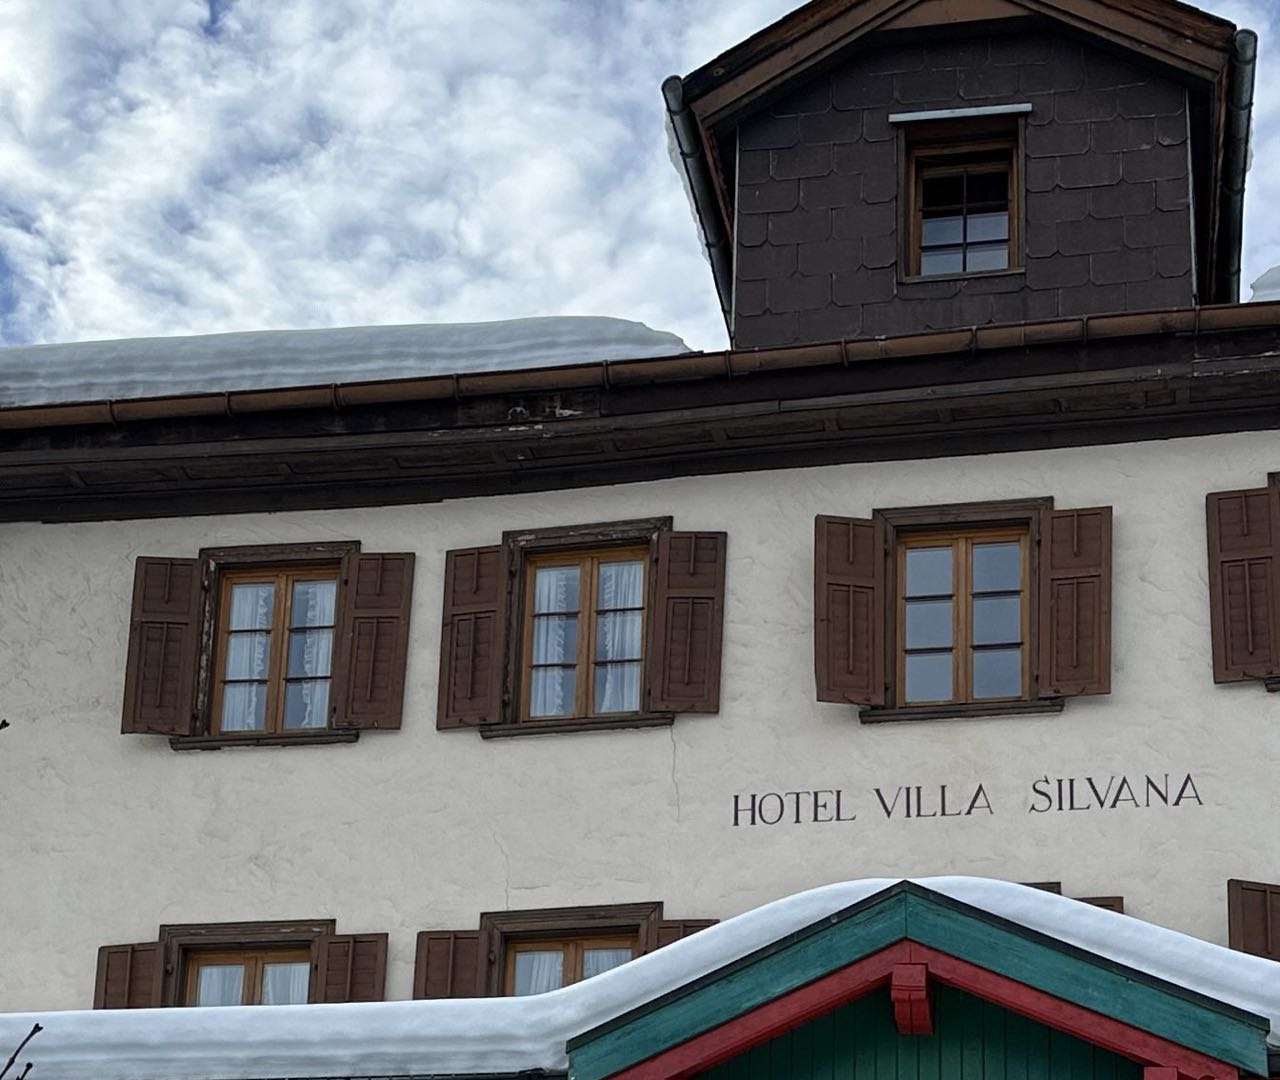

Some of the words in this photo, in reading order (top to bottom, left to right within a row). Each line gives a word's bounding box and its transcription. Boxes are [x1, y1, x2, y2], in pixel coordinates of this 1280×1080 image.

[732, 789, 857, 826] HOTEL
[873, 783, 994, 819] VILLA
[1028, 773, 1204, 813] SILVANA
